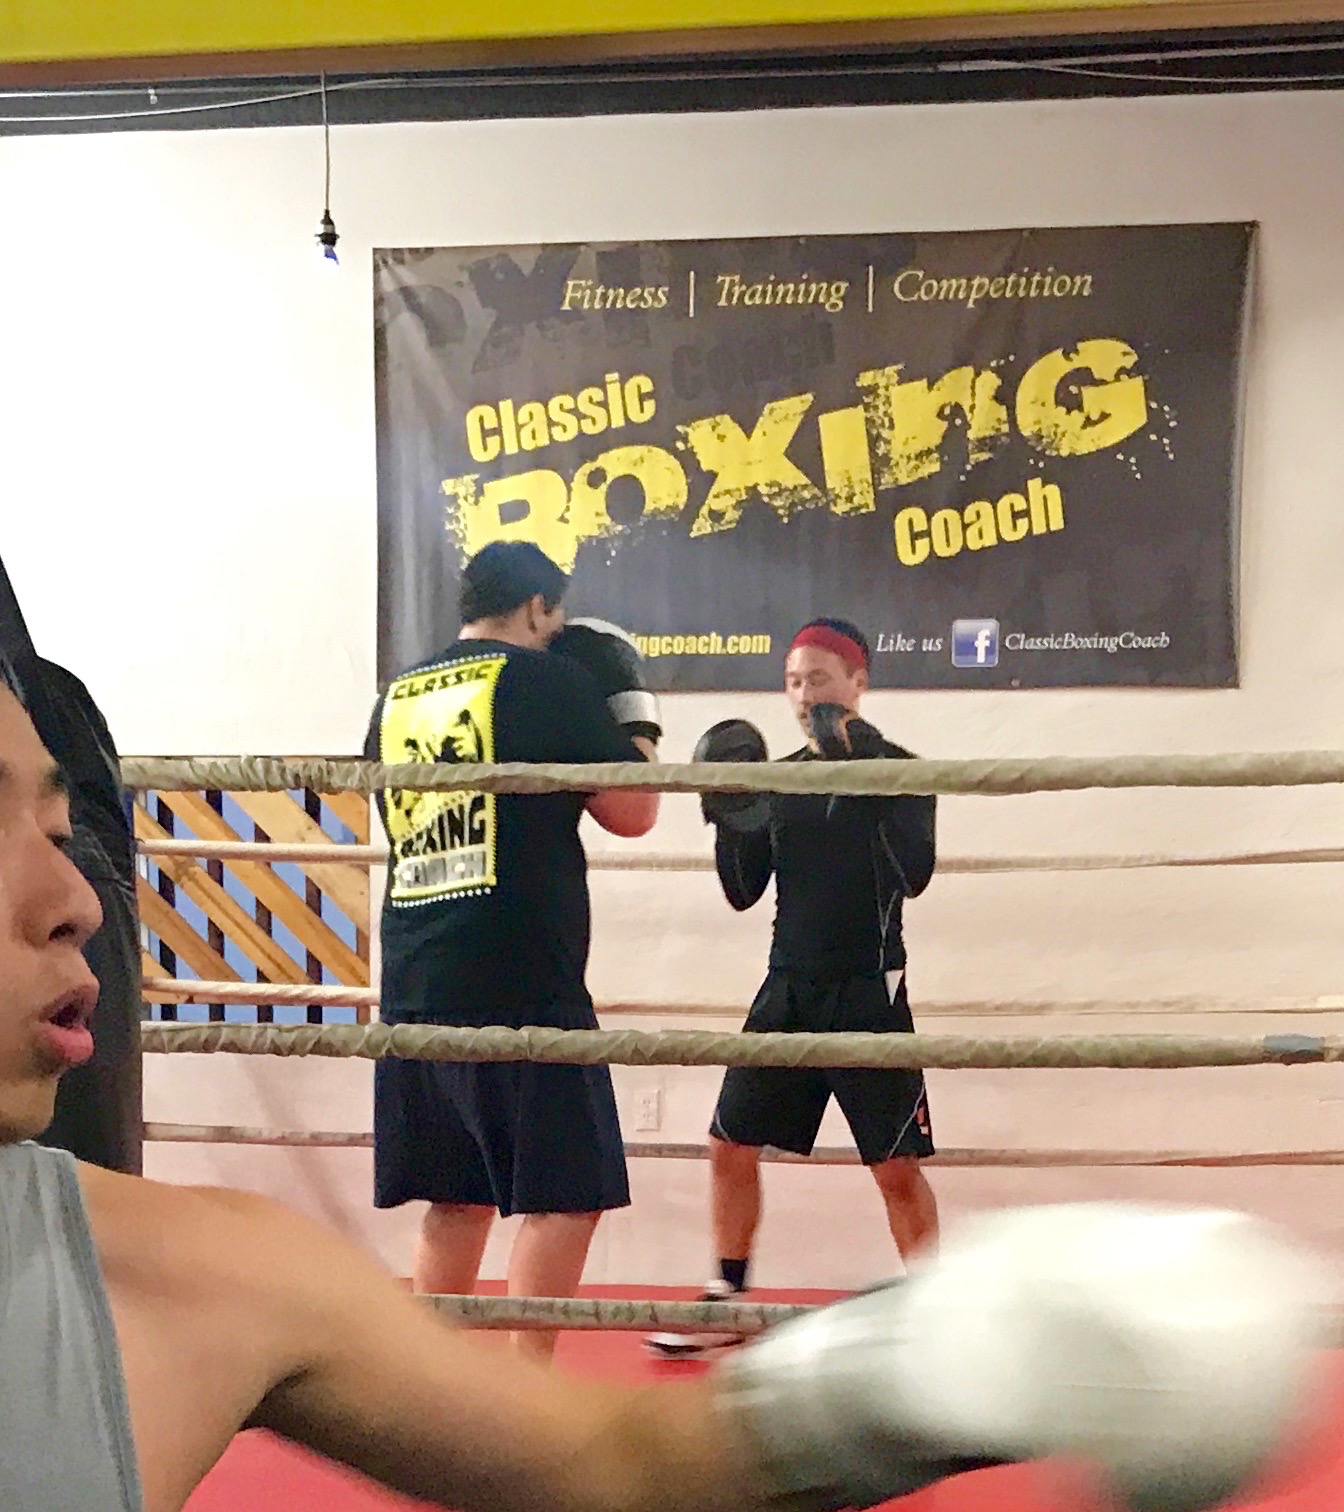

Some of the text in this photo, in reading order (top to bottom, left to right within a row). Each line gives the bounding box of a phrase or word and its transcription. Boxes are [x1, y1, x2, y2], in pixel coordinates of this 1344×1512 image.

[560, 266, 1092, 313] Fitness Training Competition
[466, 373, 656, 462] Classic
[894, 477, 1065, 566] Coach
[876, 634, 916, 653] Like
[922, 637, 943, 652] us
[1005, 632, 1170, 653] ClassicBoxingCoach
[392, 663, 492, 700] CLASSIC
